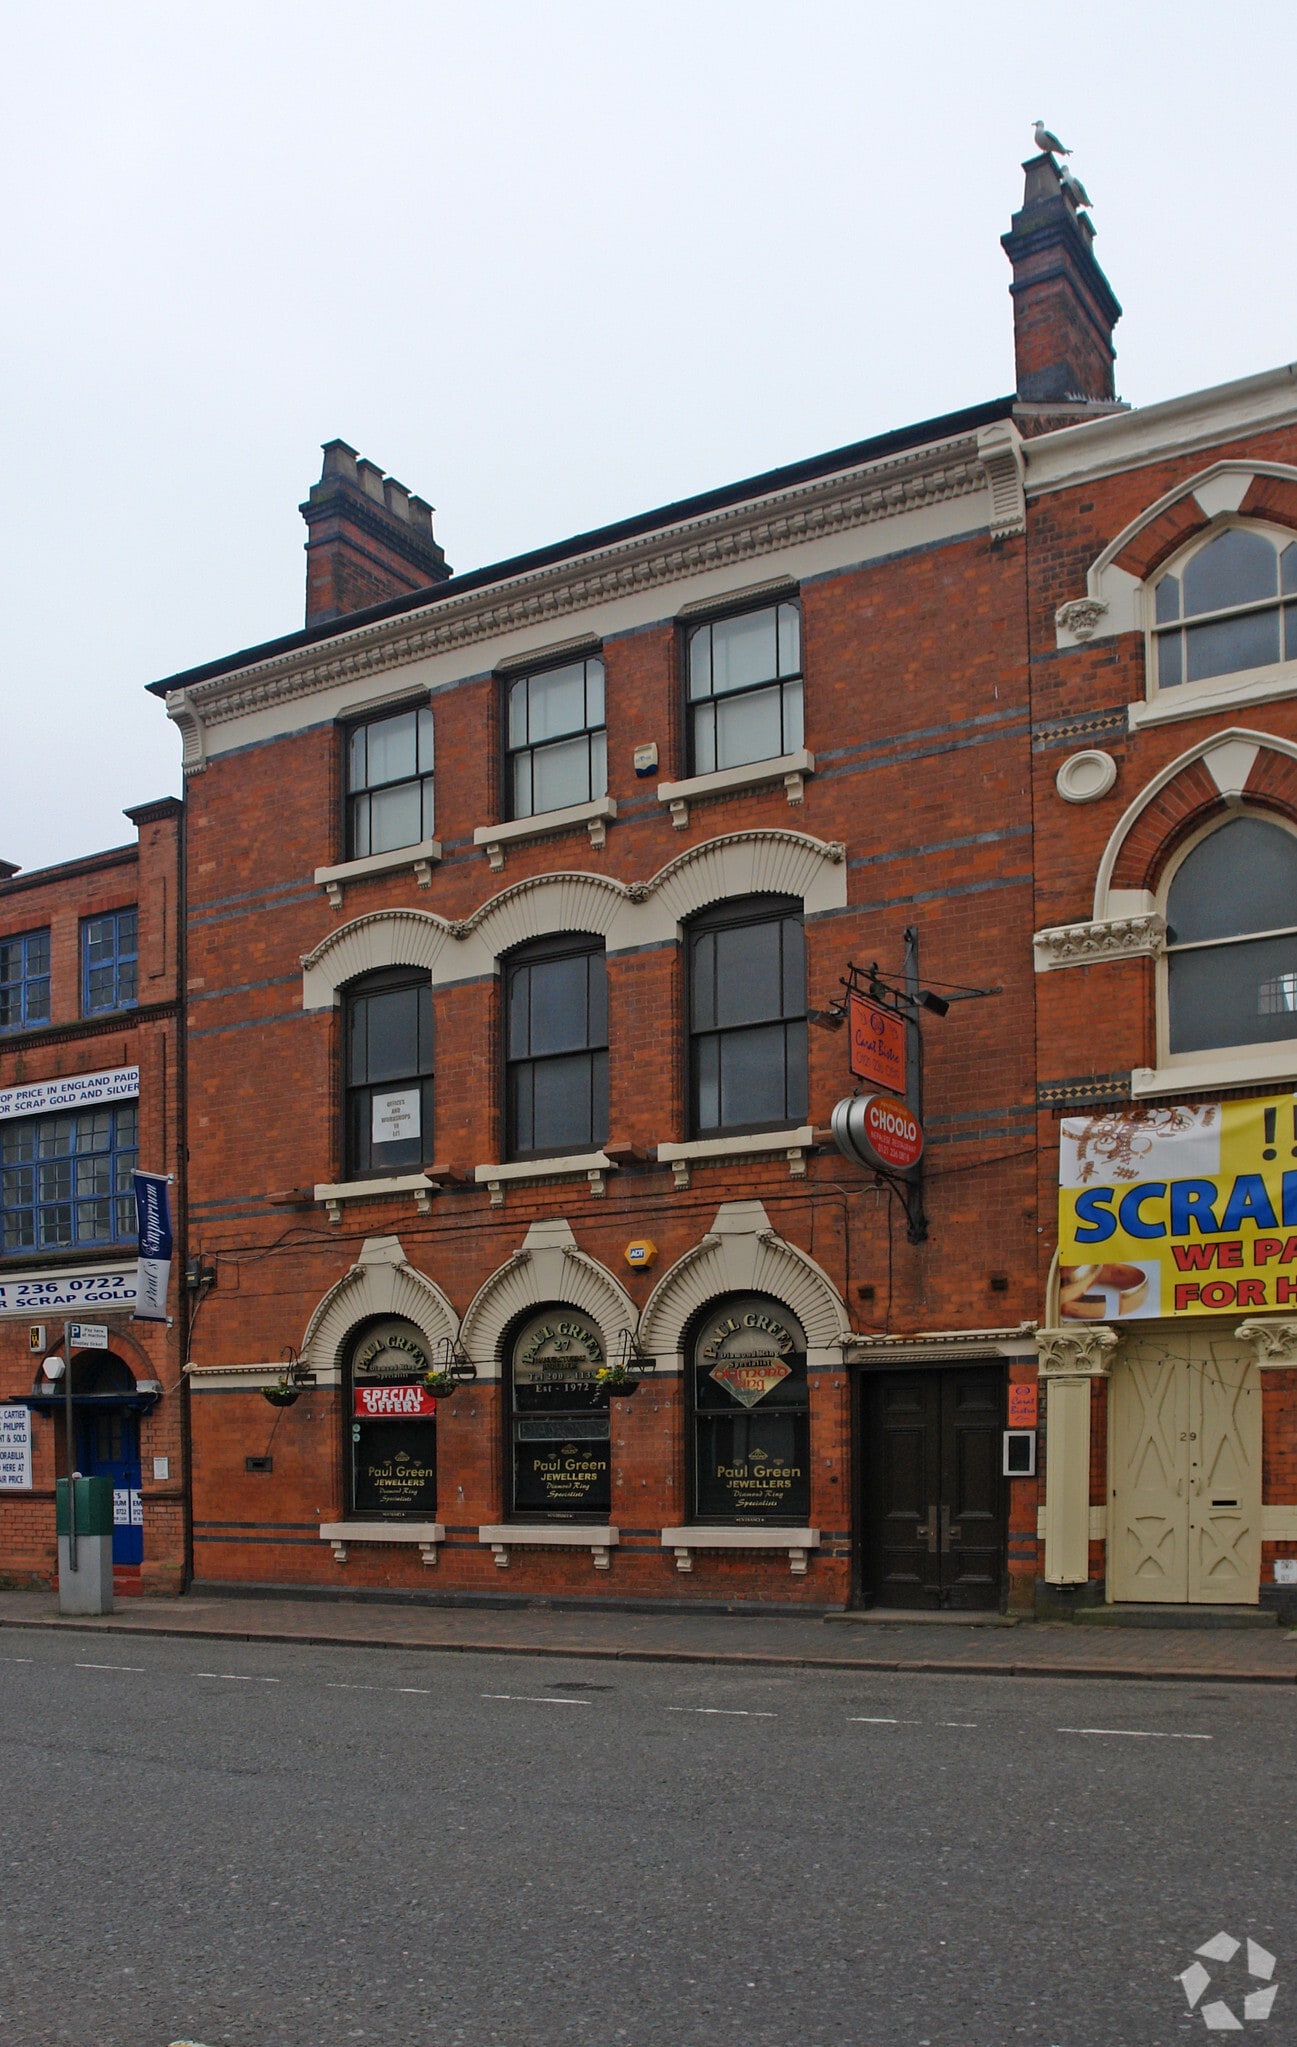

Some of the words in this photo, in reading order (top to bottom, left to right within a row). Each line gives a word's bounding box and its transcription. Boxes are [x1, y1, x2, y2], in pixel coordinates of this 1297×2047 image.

[0, 1094, 12, 1102] OP
[17, 1089, 42, 1100] PRICE
[47, 1086, 57, 1094] IN
[61, 1077, 110, 1092] ENGLAND
[114, 1072, 138, 1082] PAID
[15, 1099, 46, 1111] SCRAP
[50, 1094, 75, 1104] GOLD
[80, 1089, 102, 1100] AND
[107, 1083, 139, 1095] SILVER
[870, 1107, 916, 1142] CHOOLO
[141, 1183, 165, 1256] Emporium
[631, 1249, 644, 1257] ADT
[1170, 1240, 1244, 1272] WE
[18, 1283, 58, 1295] 236
[70, 1276, 125, 1290] 0722
[143, 1261, 159, 1308] Paul's
[16, 1295, 76, 1307] SCRAP
[84, 1290, 136, 1301] GOLD
[1175, 1278, 1267, 1311] FOR
[72, 1326, 79, 1337] P
[704, 1318, 741, 1360] PAUL
[743, 1313, 796, 1356] GREEN
[522, 1326, 554, 1364] PAUL
[558, 1321, 604, 1362] GREEN
[554, 1339, 571, 1351] 27
[357, 1339, 385, 1371] PAUL
[386, 1335, 428, 1370] GREEN
[720, 1350, 757, 1358] Diamond
[728, 1360, 772, 1368] Specialist
[529, 1373, 543, 1381] Tel
[547, 1372, 564, 1381] 200
[536, 1384, 552, 1392] Est
[565, 1383, 589, 1391] 1972
[362, 1388, 424, 1403] SPECIAL
[367, 1400, 420, 1413] OFFERS
[4, 1410, 26, 1419] CARTIER
[4, 1422, 25, 1430] PHILIPPE
[13, 1435, 27, 1443] SOLD
[1180, 1432, 1197, 1441] 29
[3, 1464, 16, 1472] HERE
[18, 1464, 24, 1472] AT
[534, 1459, 560, 1471] Paul
[565, 1459, 606, 1470] Green
[368, 1466, 392, 1477] Paul
[396, 1466, 433, 1477] Green
[717, 1465, 748, 1478] Paul
[754, 1465, 800, 1477] Green
[573, 1482, 590, 1491] Ring
[726, 1480, 791, 1488] JEWELLERS
[402, 1488, 418, 1496] Ring
[764, 1490, 784, 1499] Ring
[735, 1499, 777, 1507] Specialists
